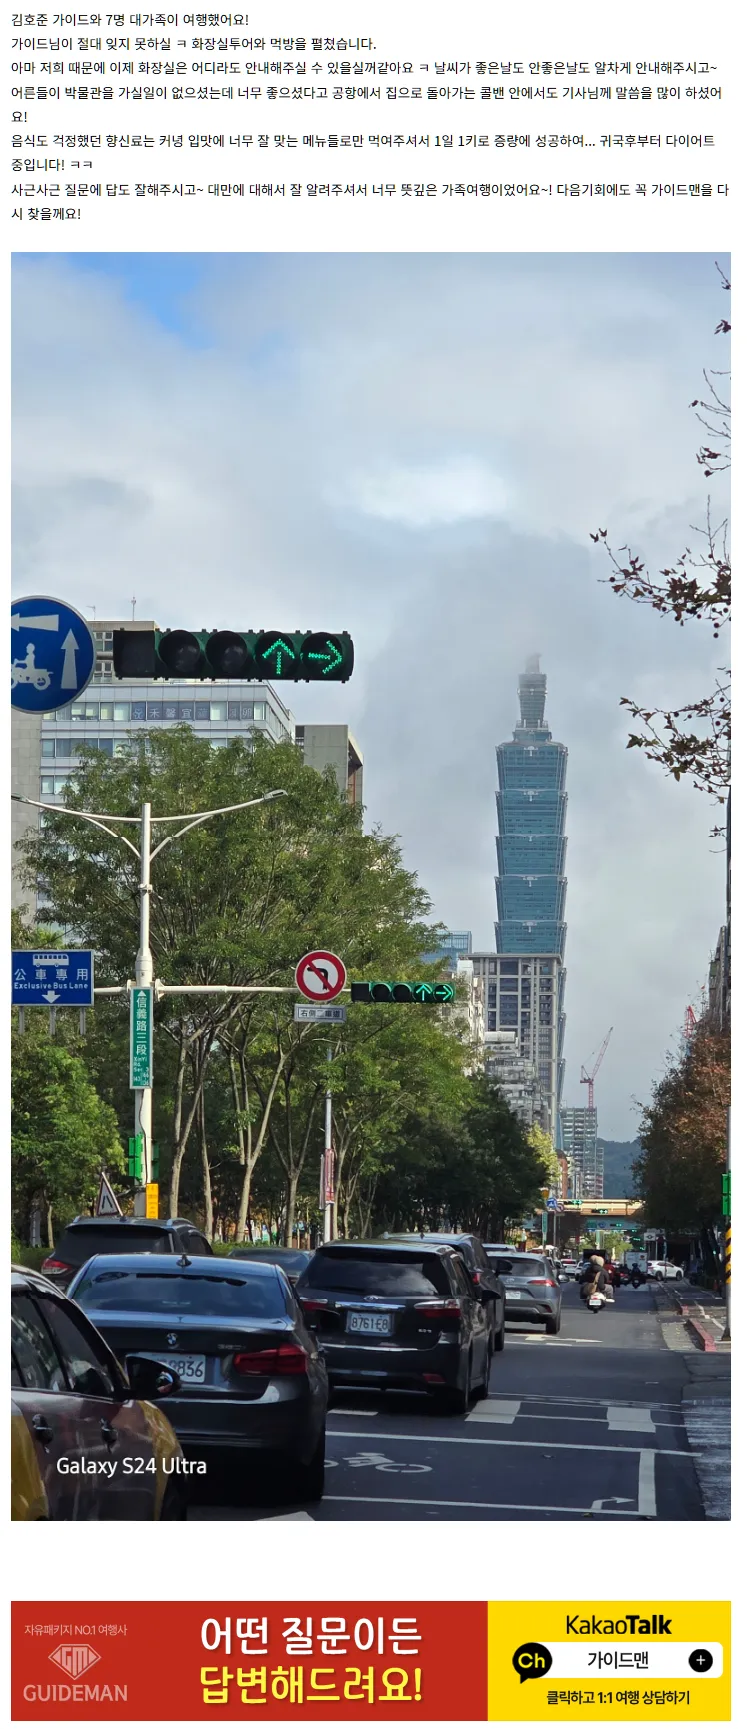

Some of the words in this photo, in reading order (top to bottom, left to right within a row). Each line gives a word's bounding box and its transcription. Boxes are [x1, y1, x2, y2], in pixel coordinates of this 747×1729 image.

[14, 968, 89, 981] 公車專用
[136, 996, 147, 1056] 信義路三段
[24, 1623, 73, 1637] 자유패키지
[75, 1623, 96, 1637] NO.1
[98, 1623, 128, 1637] 여행사
[566, 1614, 673, 1635] KakaoTalk
[200, 1616, 269, 1655] 어떤
[281, 1616, 423, 1655] 질문이든
[518, 1652, 546, 1669] Ch
[587, 1651, 649, 1670] 가이드맨
[23, 1684, 128, 1702] GUIDEMAN
[200, 1665, 423, 1705] 답변해드려요!
[546, 1690, 595, 1705] 클릭하고
[597, 1690, 613, 1705] 1:1
[615, 1690, 640, 1705] 여행
[641, 1690, 690, 1705] 상담하기
